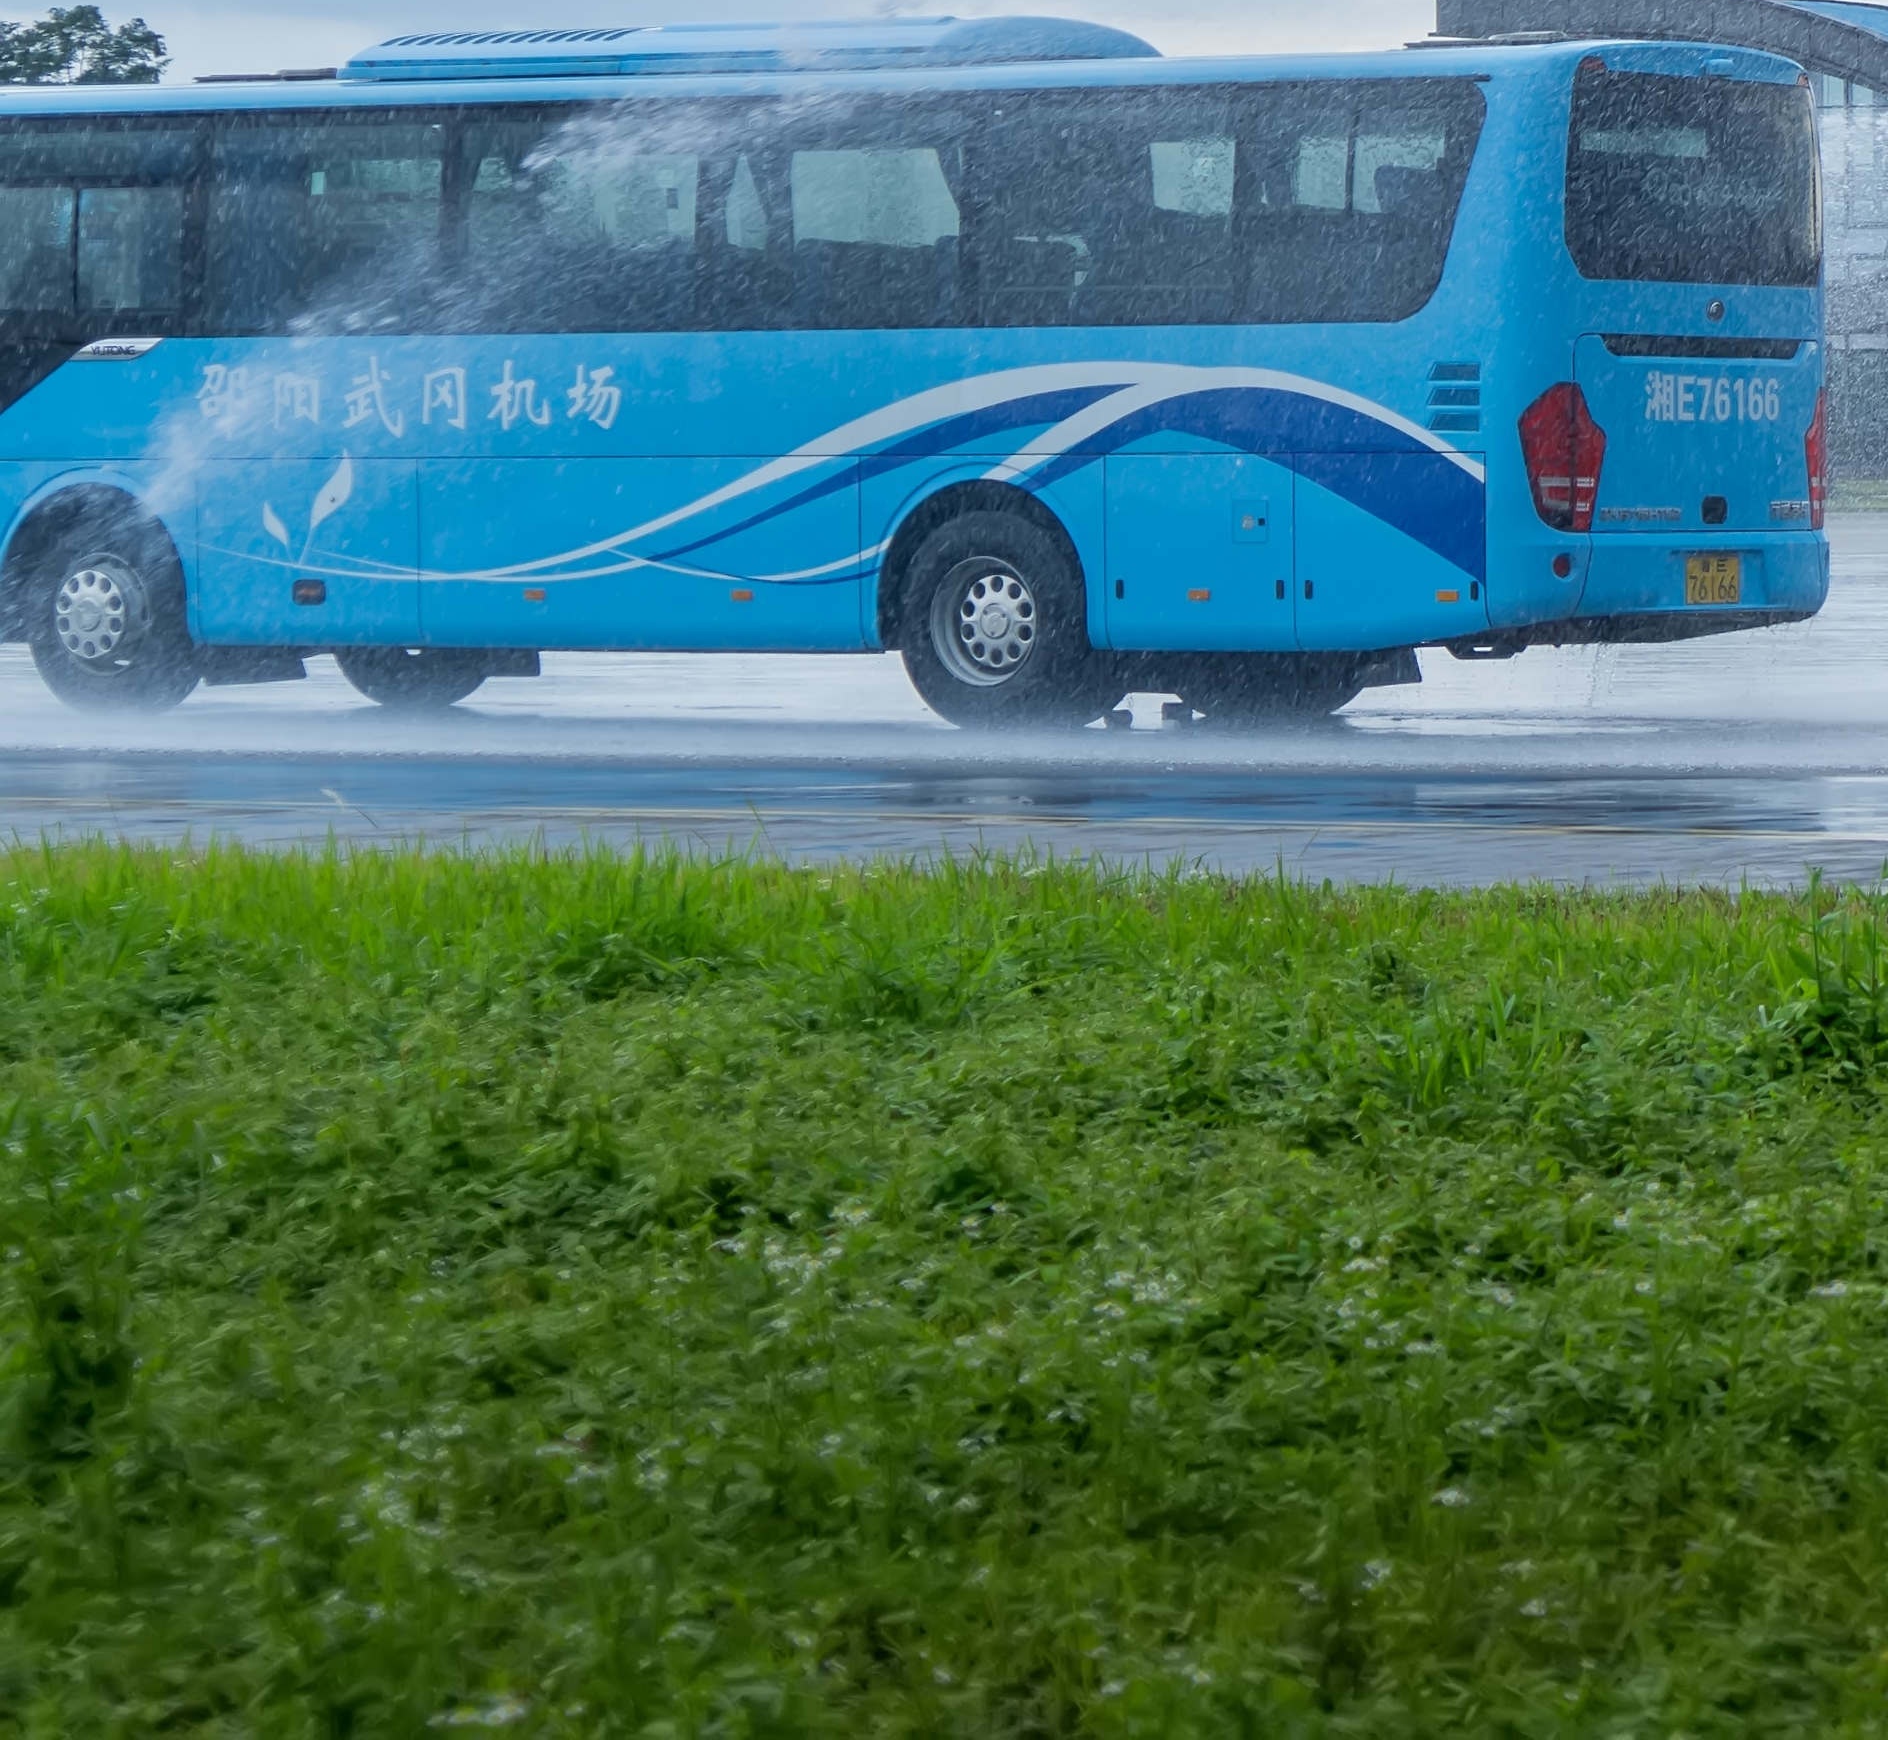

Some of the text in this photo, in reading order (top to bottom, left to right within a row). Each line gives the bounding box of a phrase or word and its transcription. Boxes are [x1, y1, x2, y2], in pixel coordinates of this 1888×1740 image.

[90, 345, 136, 356] YUTONG
[197, 356, 621, 438] 邵阳武冈机场
[1645, 370, 1780, 421] 湘E76166
[1688, 574, 1737, 601] 76166
